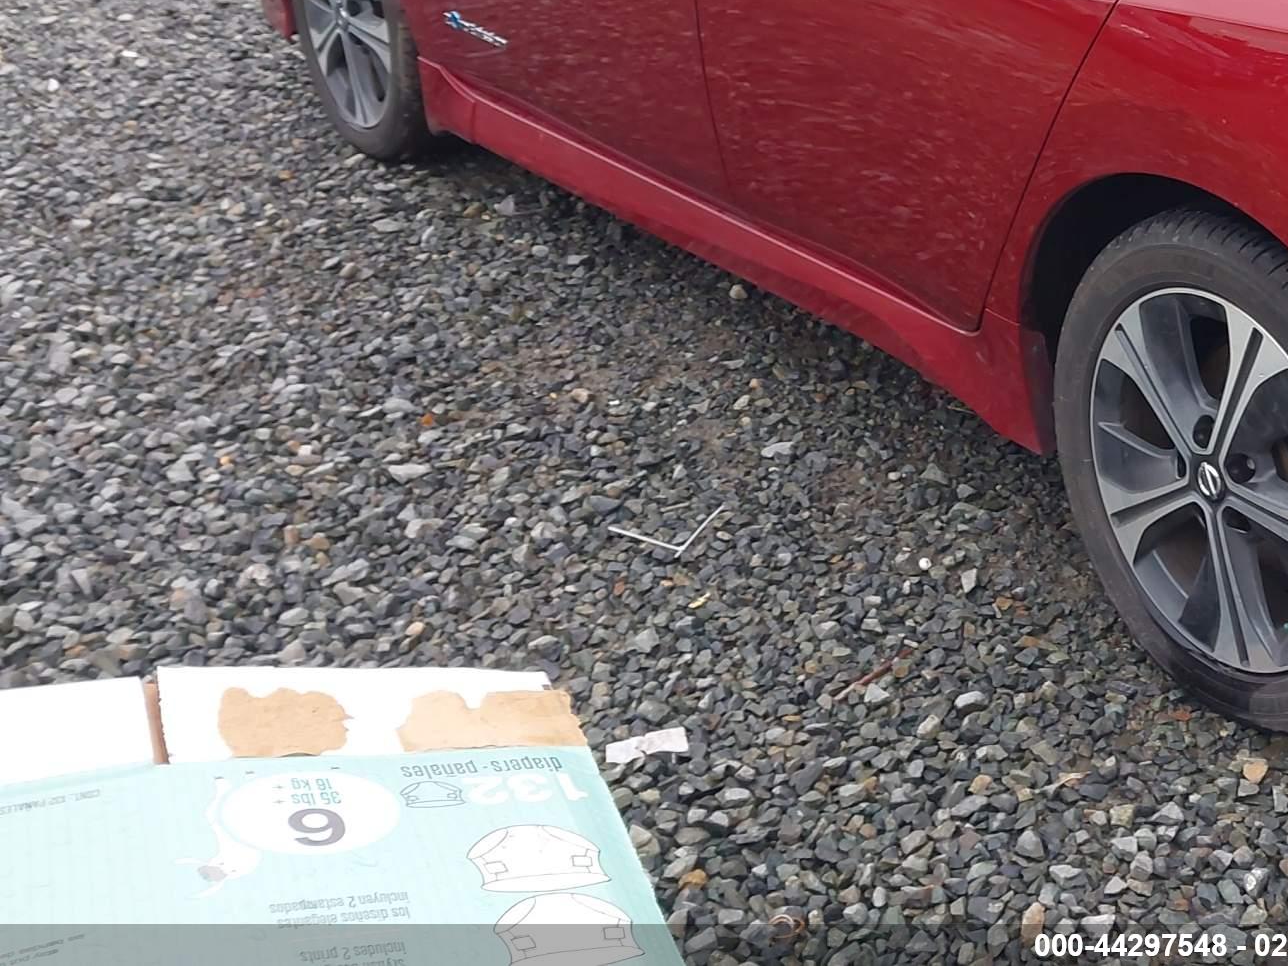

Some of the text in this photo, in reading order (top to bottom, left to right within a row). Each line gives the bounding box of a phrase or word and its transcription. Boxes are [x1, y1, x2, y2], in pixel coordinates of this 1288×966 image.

[399, 759, 478, 780] pañales
[494, 755, 563, 773] diapers
[460, 772, 589, 805] 132
[290, 792, 316, 807] lbs
[320, 790, 342, 805] 35
[287, 808, 346, 847] 6
[346, 895, 357, 909] 2
[300, 945, 339, 963] prints
[341, 946, 351, 961] 2
[352, 941, 408, 957] includes
